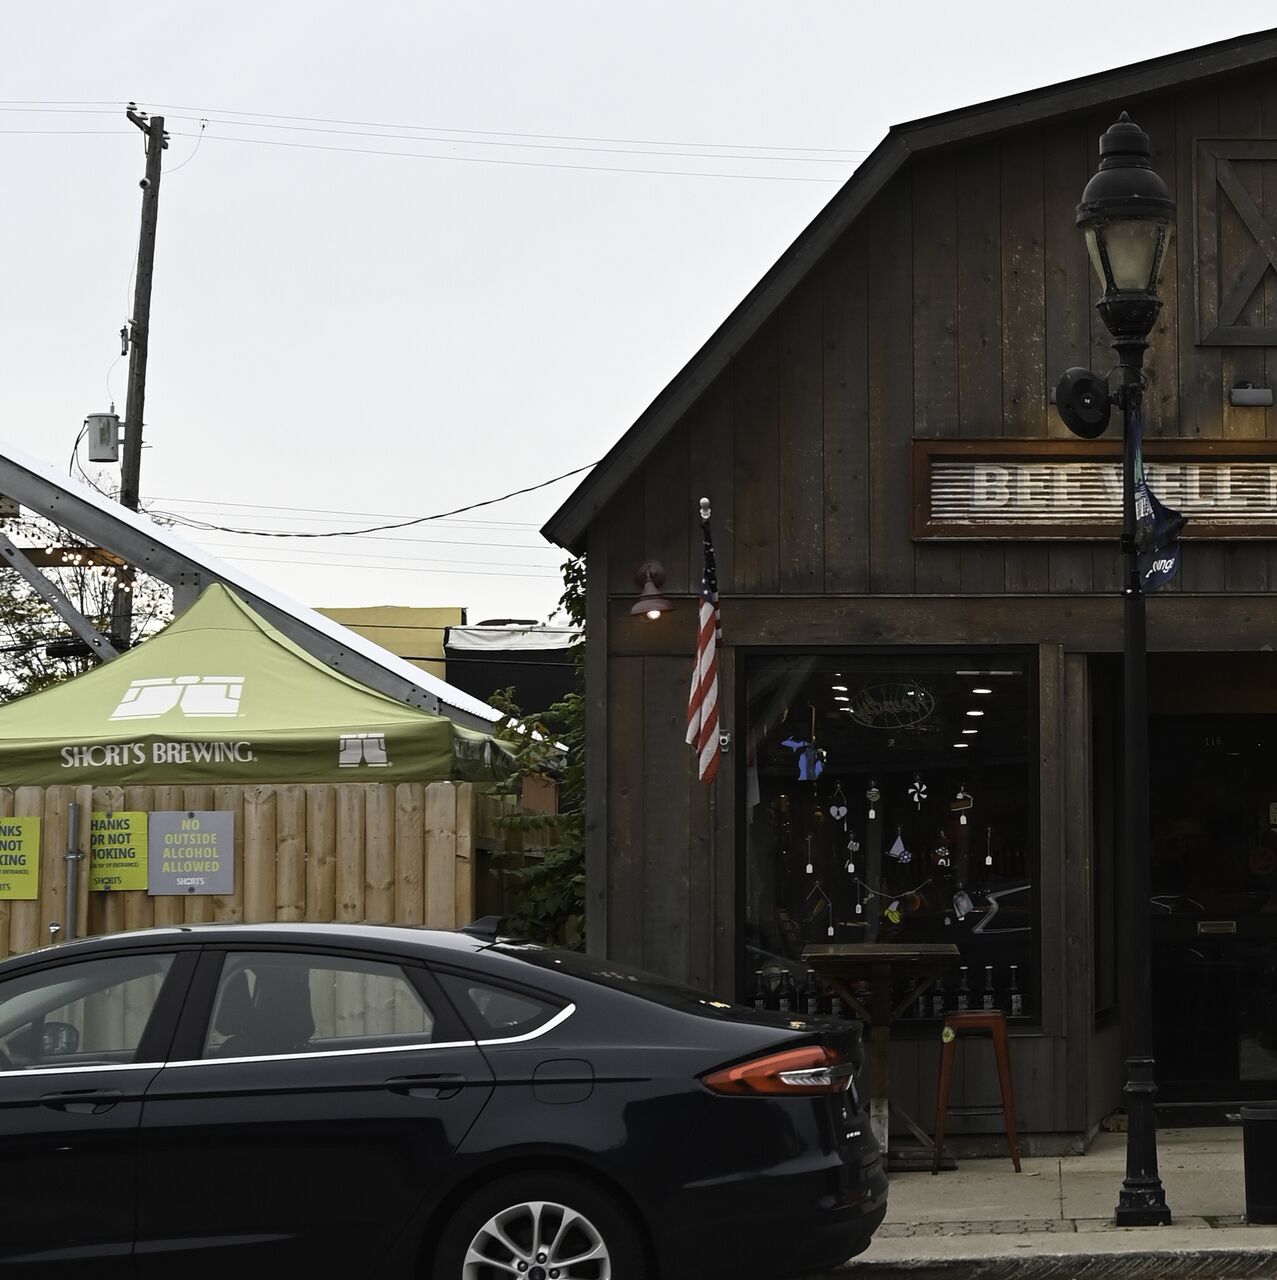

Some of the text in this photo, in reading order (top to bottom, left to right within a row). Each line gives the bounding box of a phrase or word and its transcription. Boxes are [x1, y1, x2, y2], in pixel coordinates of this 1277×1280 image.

[973, 465, 1083, 507] BEE
[61, 743, 146, 768] SHORT'S
[91, 818, 130, 831] HANKS
[181, 819, 200, 831] NO
[0, 825, 22, 837] NKS
[91, 833, 132, 846] OR NOT
[164, 833, 217, 845] OUTSIDE
[91, 847, 136, 860] OKING
[162, 847, 219, 859] ALCOHOL
[161, 861, 220, 873] ALLOWED
